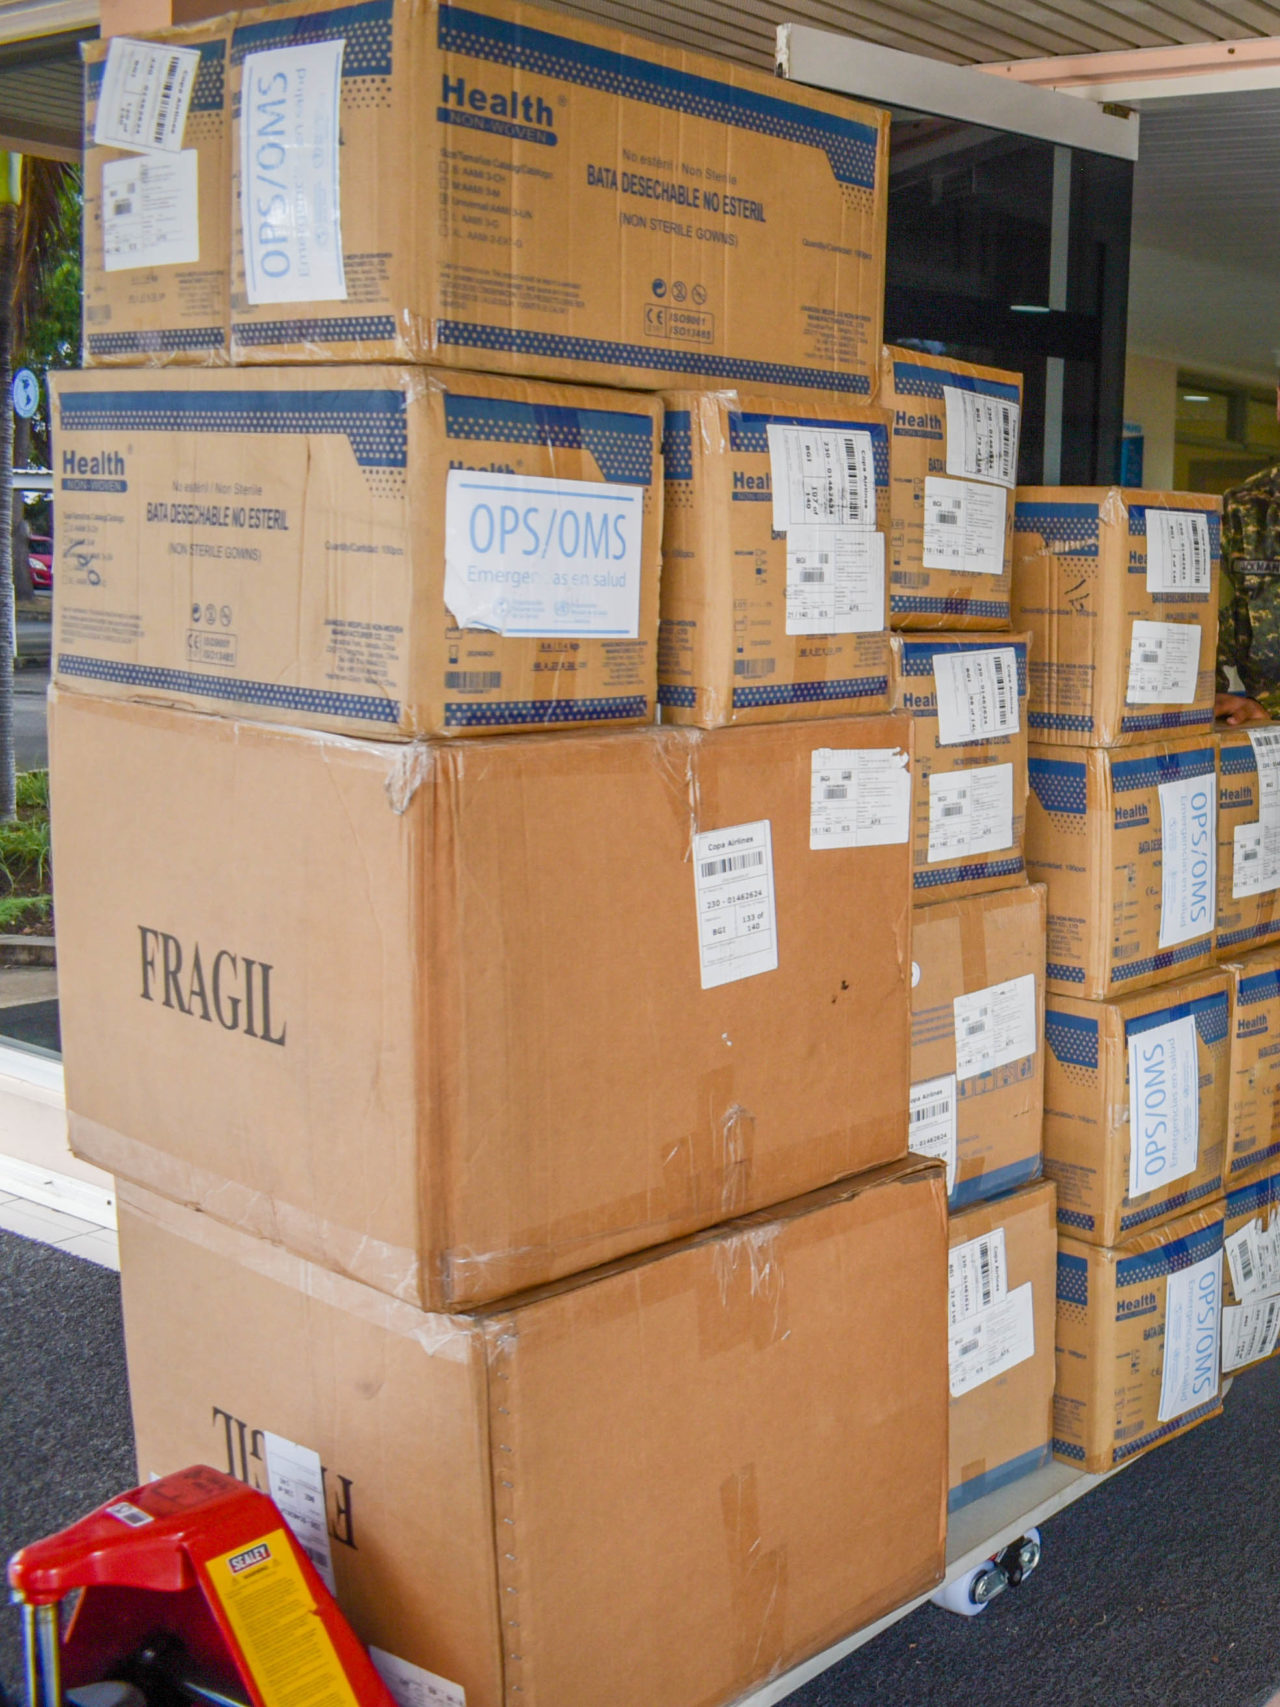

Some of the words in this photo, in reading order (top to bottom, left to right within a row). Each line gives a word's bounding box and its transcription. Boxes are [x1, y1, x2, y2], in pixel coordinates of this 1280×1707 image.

[441, 73, 554, 127] Health
[450, 112, 548, 144] NON-WOVEN
[256, 72, 291, 278] OPS/OMS
[587, 163, 618, 191] BATA
[621, 171, 700, 208] DESECHABLE
[703, 191, 720, 212] NO
[722, 195, 767, 223] ESTERIL
[650, 217, 694, 239] STERILE
[895, 410, 942, 430] Health
[62, 450, 125, 476] Health
[732, 471, 771, 490] Heal
[146, 502, 169, 522] BATA
[170, 503, 230, 526] DESECHABLE
[231, 507, 246, 527] NO
[248, 508, 289, 531] ESTERIL
[469, 503, 627, 560] OPS/OMS
[592, 572, 626, 588] salud
[1219, 786, 1252, 802] Health
[1114, 803, 1149, 821] Health
[707, 843, 725, 851] Copa
[728, 837, 754, 847] Airlines
[1190, 791, 1208, 923] OPS/OMS
[707, 899, 720, 909] 230
[727, 889, 763, 904] 01462624
[757, 911, 764, 919] of
[712, 926, 726, 936] BGI
[747, 923, 760, 932] 140
[137, 925, 288, 1047] FRAGIL
[1237, 1013, 1268, 1030] Health
[922, 1090, 943, 1099] Airlines
[1143, 1043, 1168, 1176] OPS/OMS
[1116, 1293, 1156, 1313] Health
[1192, 1271, 1216, 1394] OPS/OMS
[230, 1544, 268, 1571] SEALEY
